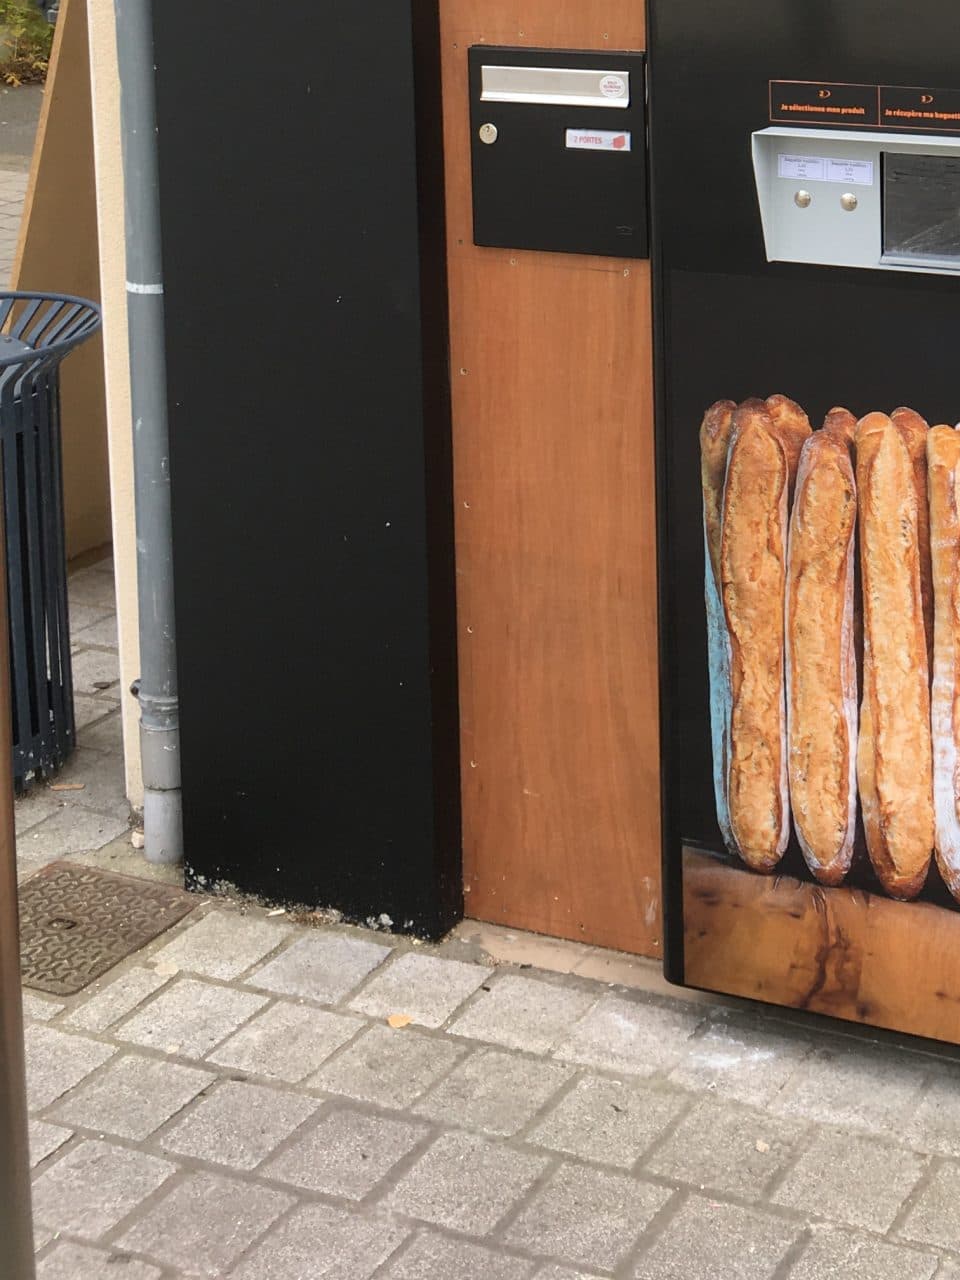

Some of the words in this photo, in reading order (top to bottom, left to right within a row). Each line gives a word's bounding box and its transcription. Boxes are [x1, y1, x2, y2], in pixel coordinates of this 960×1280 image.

[781, 103, 788, 111] Je
[841, 107, 865, 115] produit
[893, 109, 922, 118] récupère
